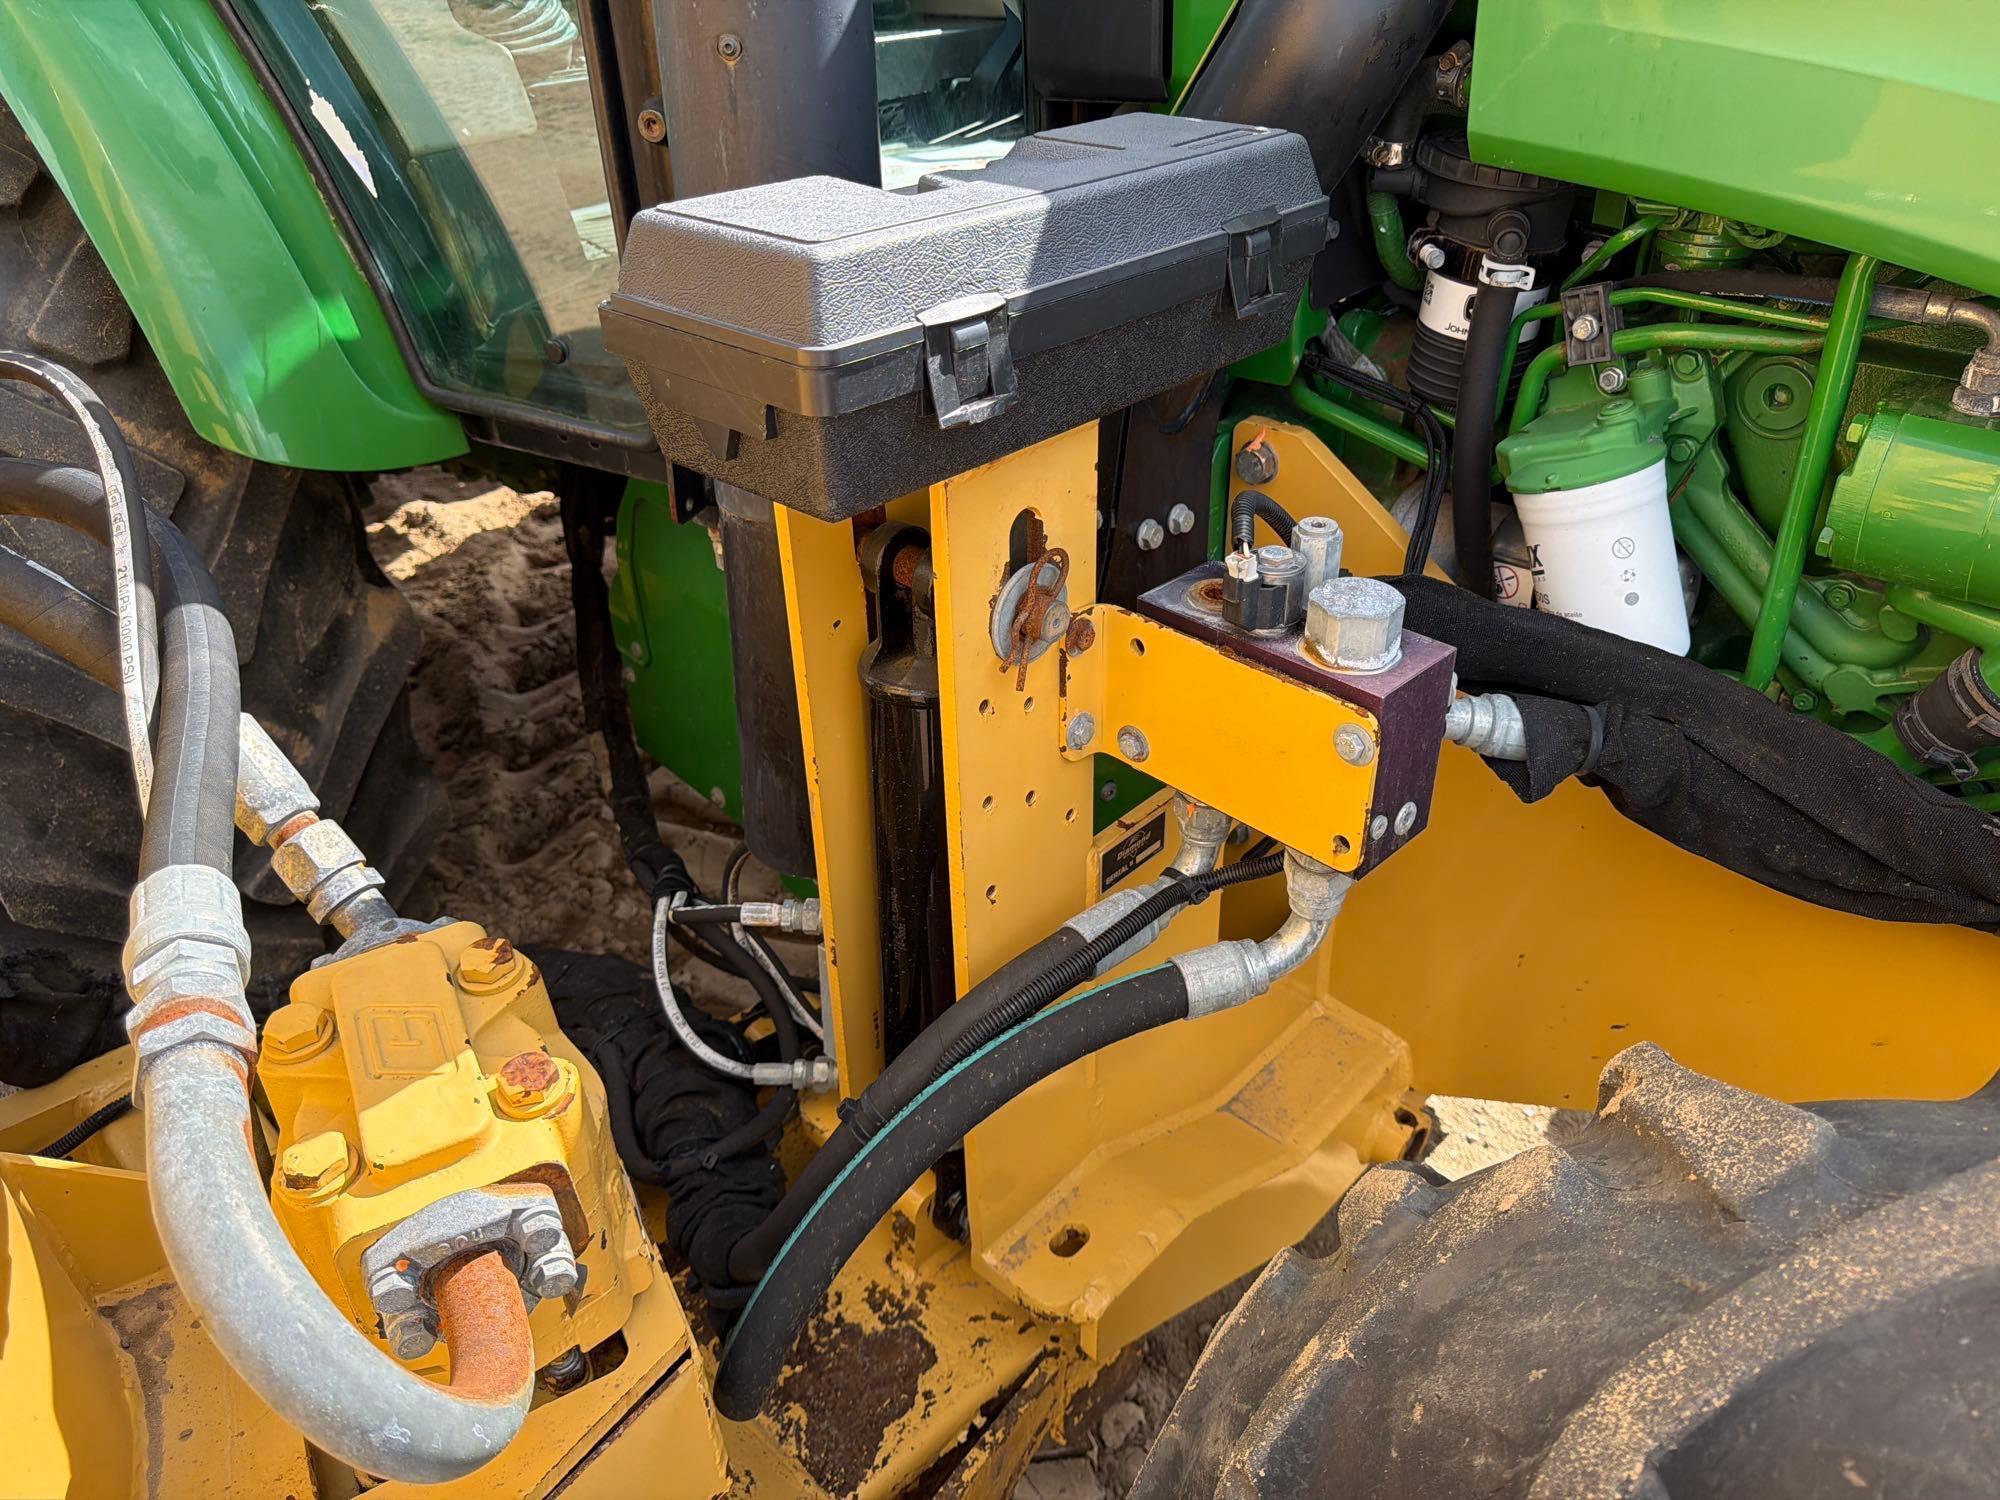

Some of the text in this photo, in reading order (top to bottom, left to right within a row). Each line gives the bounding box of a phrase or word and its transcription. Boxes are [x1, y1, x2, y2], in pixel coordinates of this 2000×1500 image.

[117, 565, 129, 580] 21
[119, 583, 131, 613] MPa
[120, 615, 133, 652] (3000
[123, 655, 137, 685] PSI)
[1105, 864, 1128, 884] SERIAL
